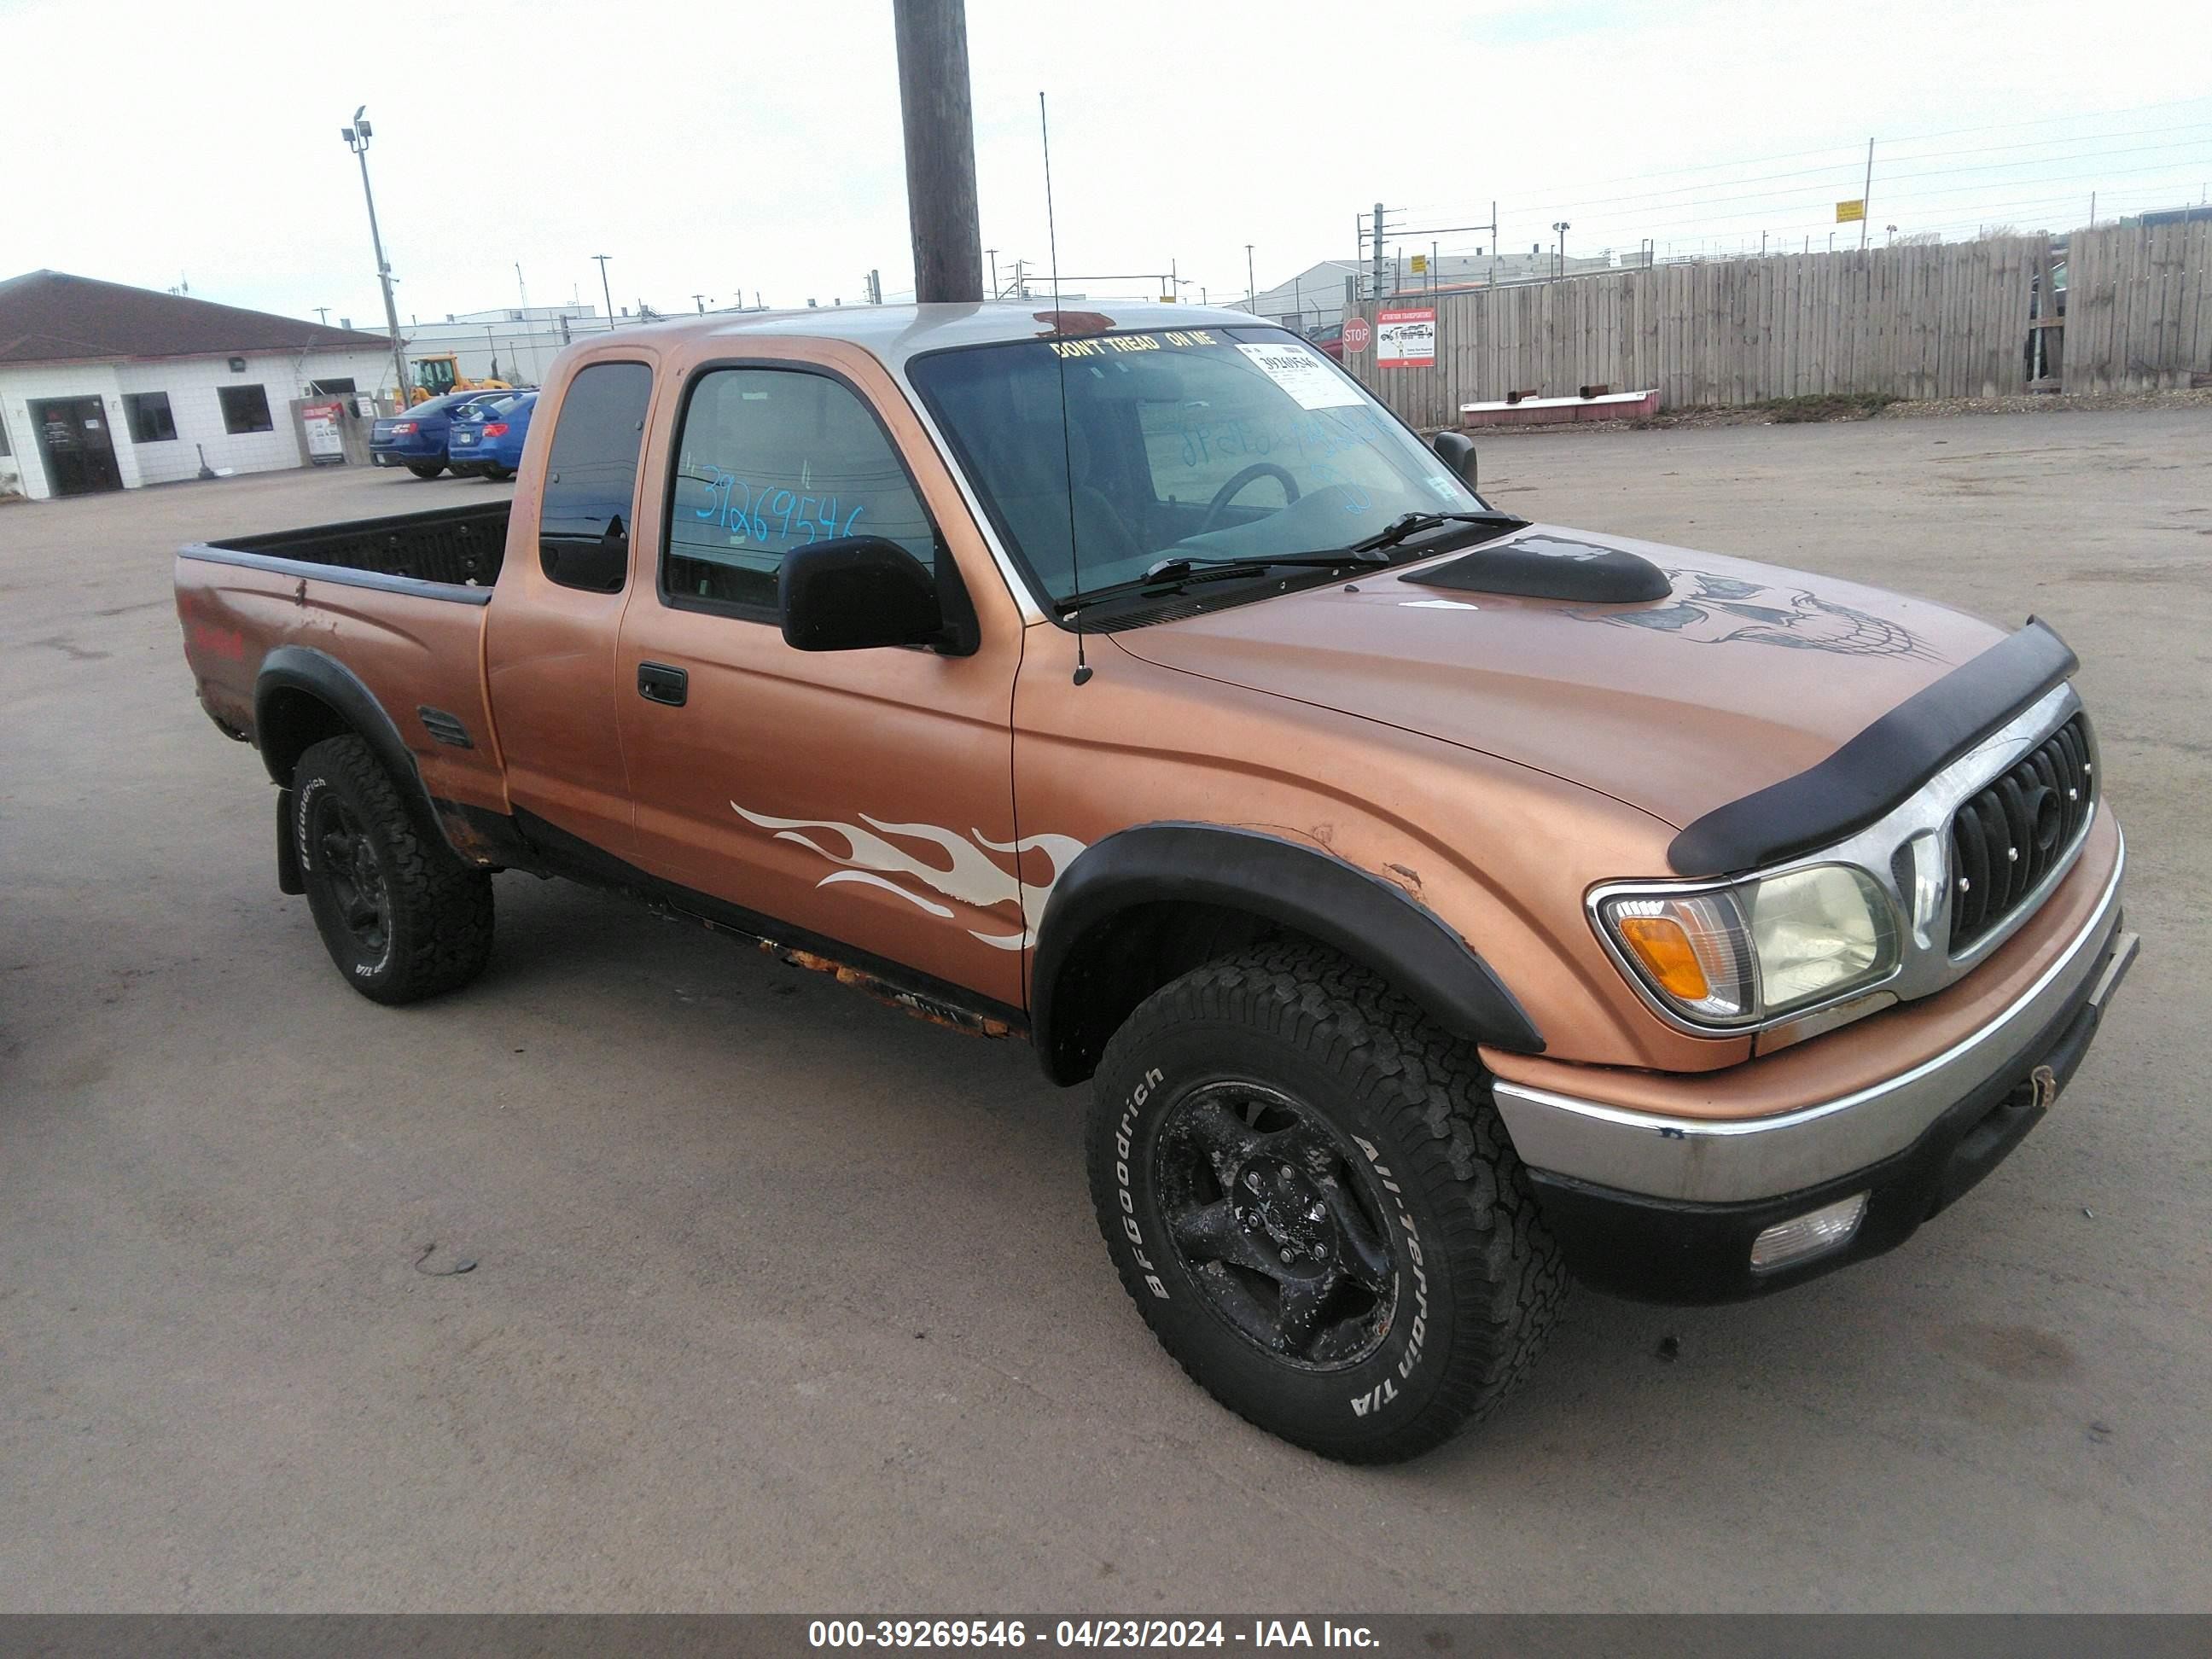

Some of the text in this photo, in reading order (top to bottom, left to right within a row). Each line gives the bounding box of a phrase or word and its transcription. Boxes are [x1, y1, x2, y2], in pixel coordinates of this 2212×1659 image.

[1050, 330, 1218, 358] DON'T TREAD ON ME
[1344, 328, 1368, 342] STOP
[1259, 356, 1319, 370] 39269546
[696, 464, 865, 544] 39269546
[1115, 1067, 1170, 1300] BFGoodrich
[1349, 1377, 1399, 1417] T/A
